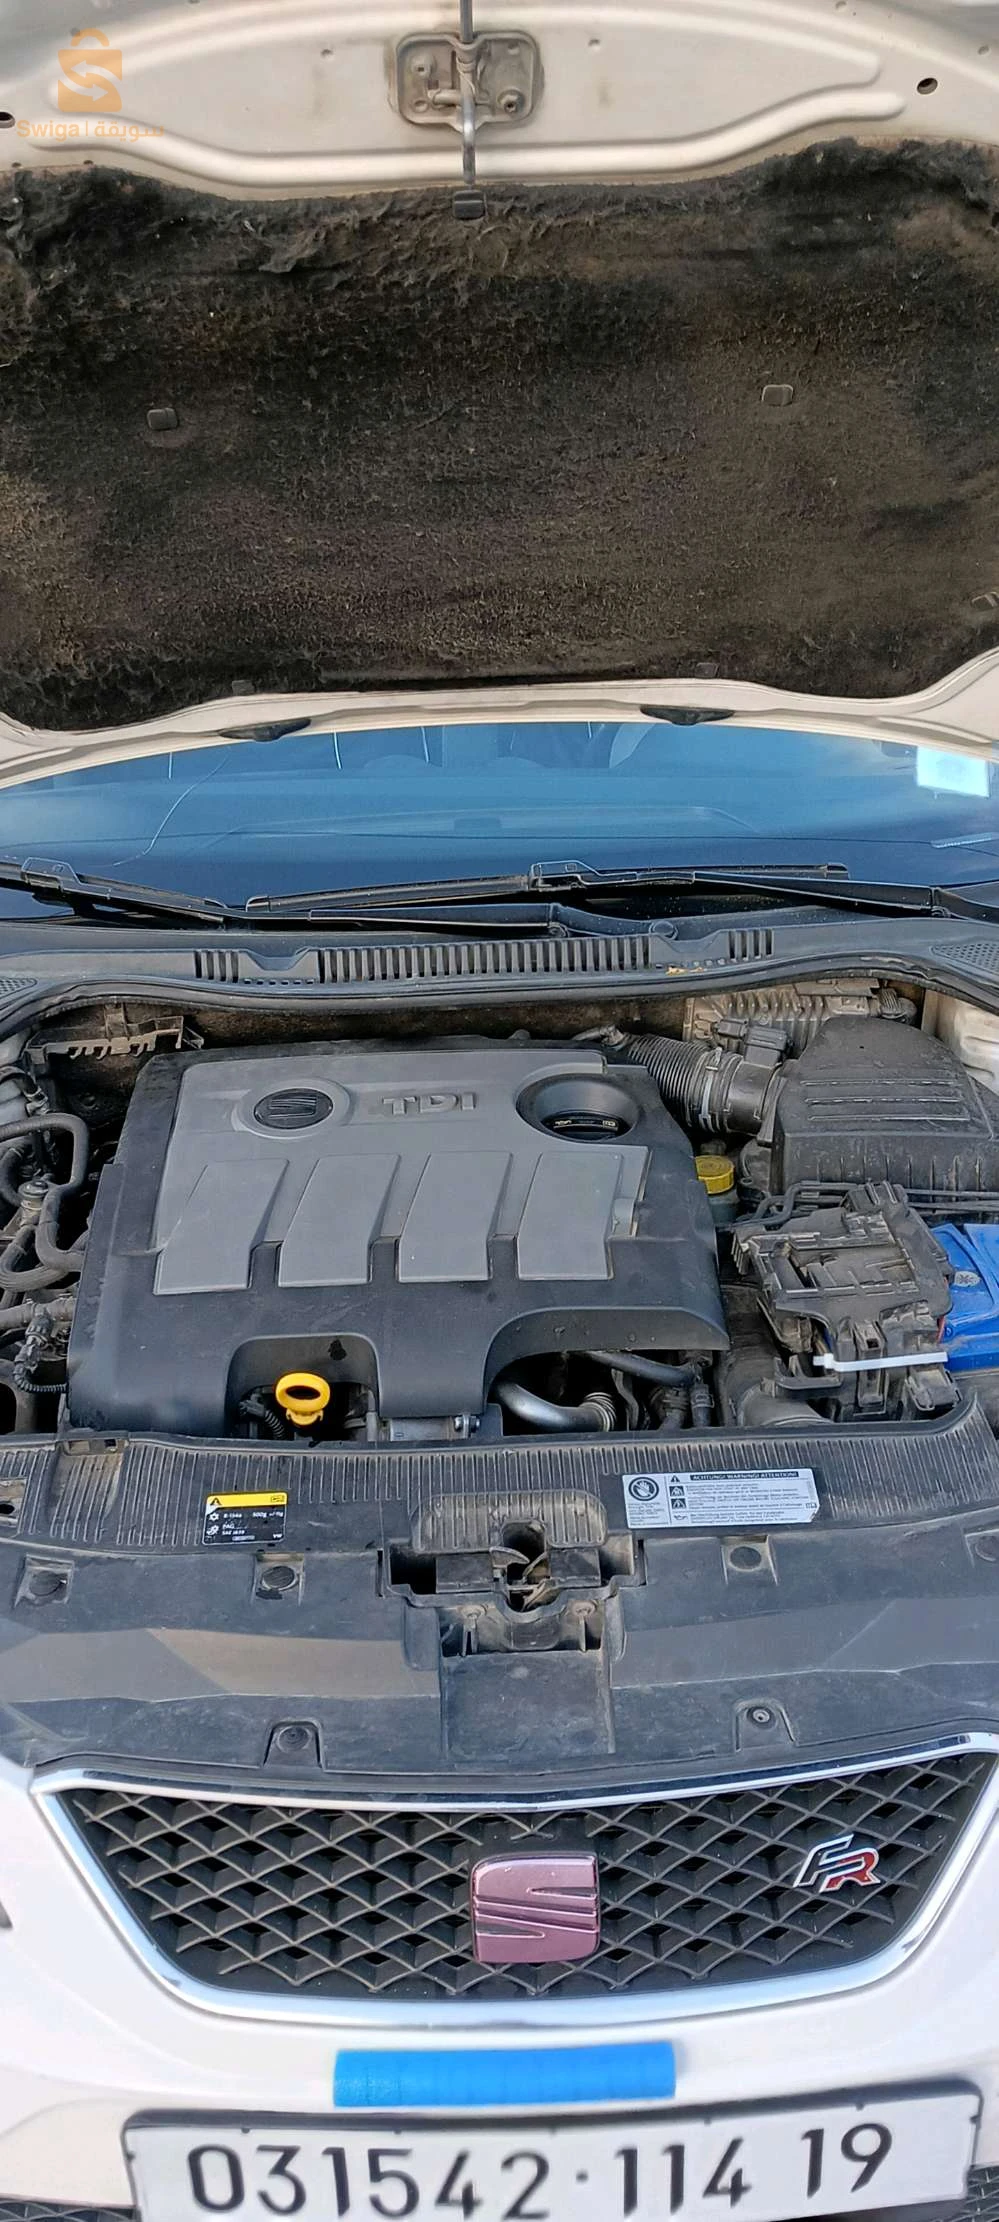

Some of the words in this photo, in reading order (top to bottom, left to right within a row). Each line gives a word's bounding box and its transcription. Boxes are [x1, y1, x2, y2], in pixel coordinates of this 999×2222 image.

[382, 1092, 476, 1115] TDI
[793, 1834, 881, 1893] FR
[186, 2143, 551, 2220] 031542
[614, 2136, 754, 2217] 114
[801, 2122, 893, 2200] 19
